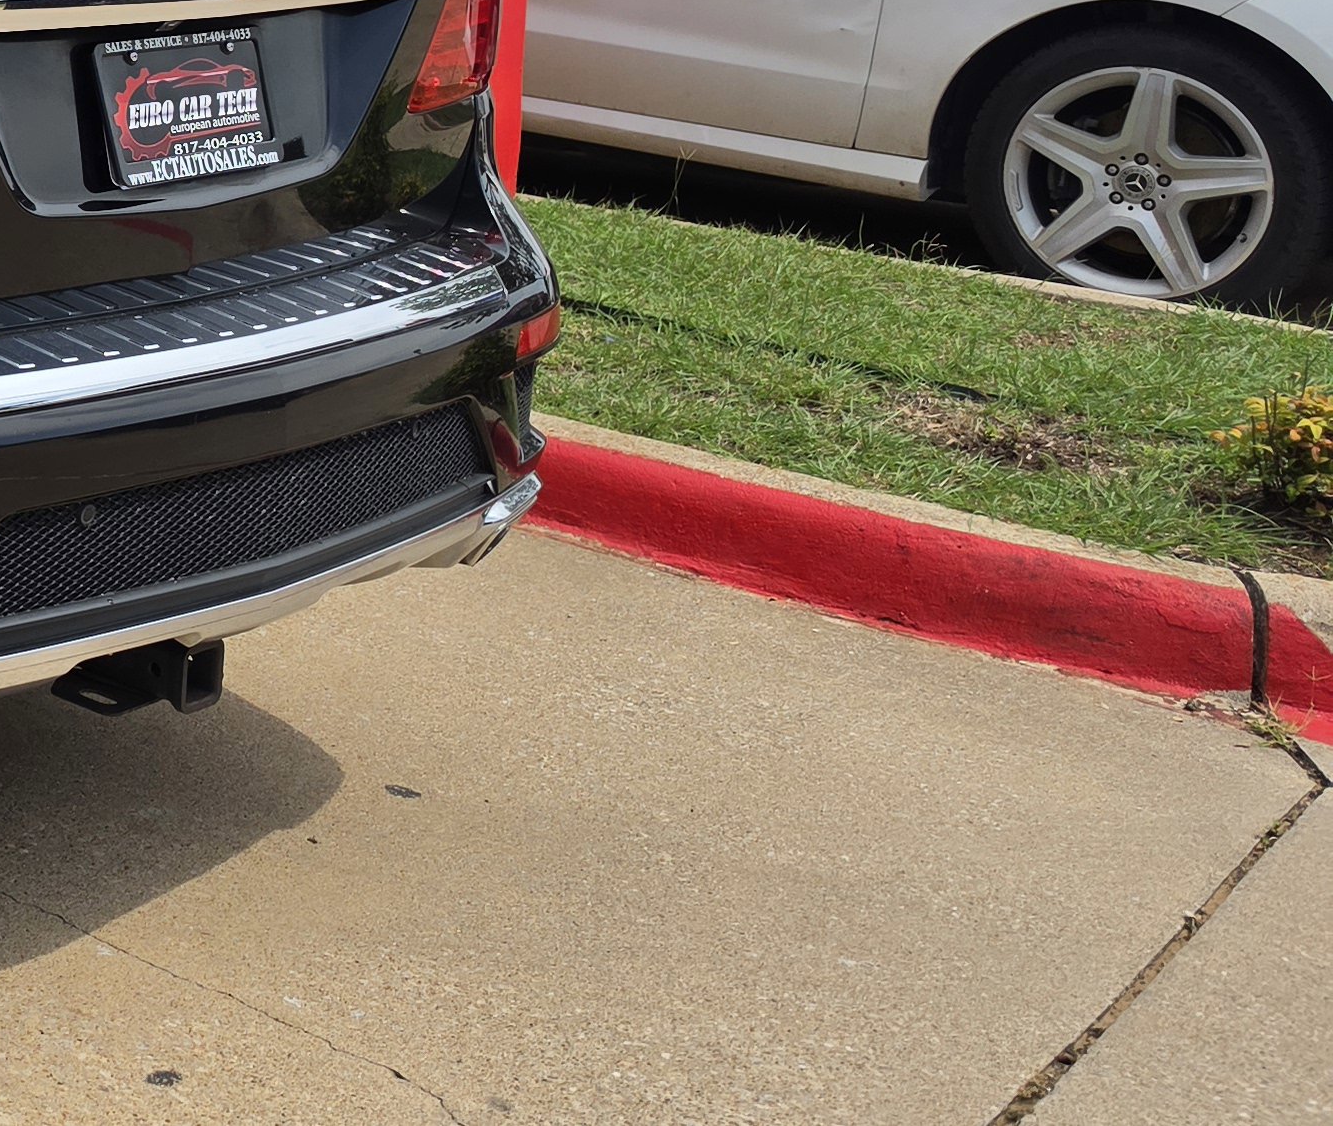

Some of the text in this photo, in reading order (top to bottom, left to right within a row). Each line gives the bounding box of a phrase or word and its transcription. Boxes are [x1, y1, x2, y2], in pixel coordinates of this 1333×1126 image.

[104, 28, 251, 54] SALES & SERVICE 817-404-4033
[128, 88, 258, 130] EURO CAR TECH
[170, 111, 260, 134] european automotive
[173, 131, 264, 155] 817-404-4033
[128, 145, 279, 186] www.ECTAUTOSALES.com
